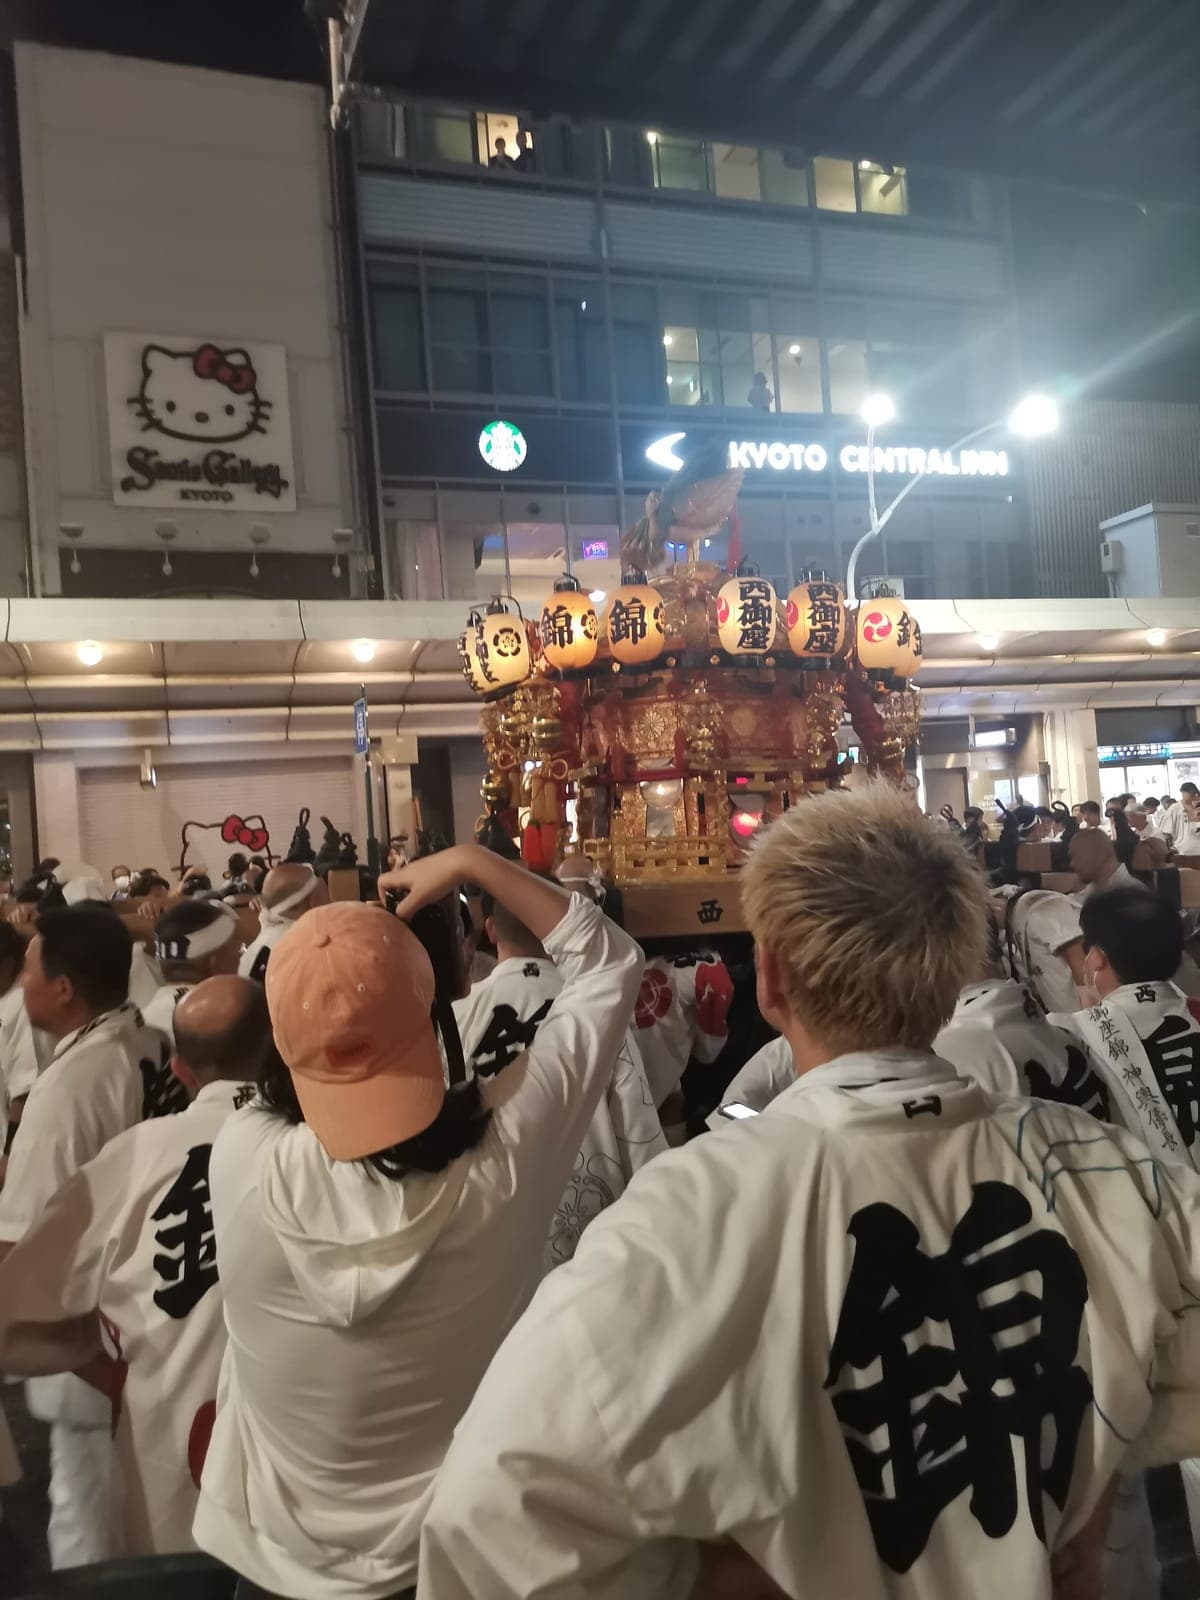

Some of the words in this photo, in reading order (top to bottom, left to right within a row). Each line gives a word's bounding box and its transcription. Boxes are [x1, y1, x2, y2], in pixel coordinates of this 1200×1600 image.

[728, 440, 828, 472] KYOTO
[840, 445, 960, 475] CENTRAL
[960, 449, 1009, 476] INN
[180, 488, 233, 502] KYOTO
[541, 606, 574, 648] 錦
[609, 597, 647, 646] 錦
[737, 581, 773, 649] 西御座
[802, 584, 841, 653] 西御座
[697, 899, 723, 925] 西
[1134, 984, 1157, 1004] 西
[823, 1181, 1094, 1574] 錦
